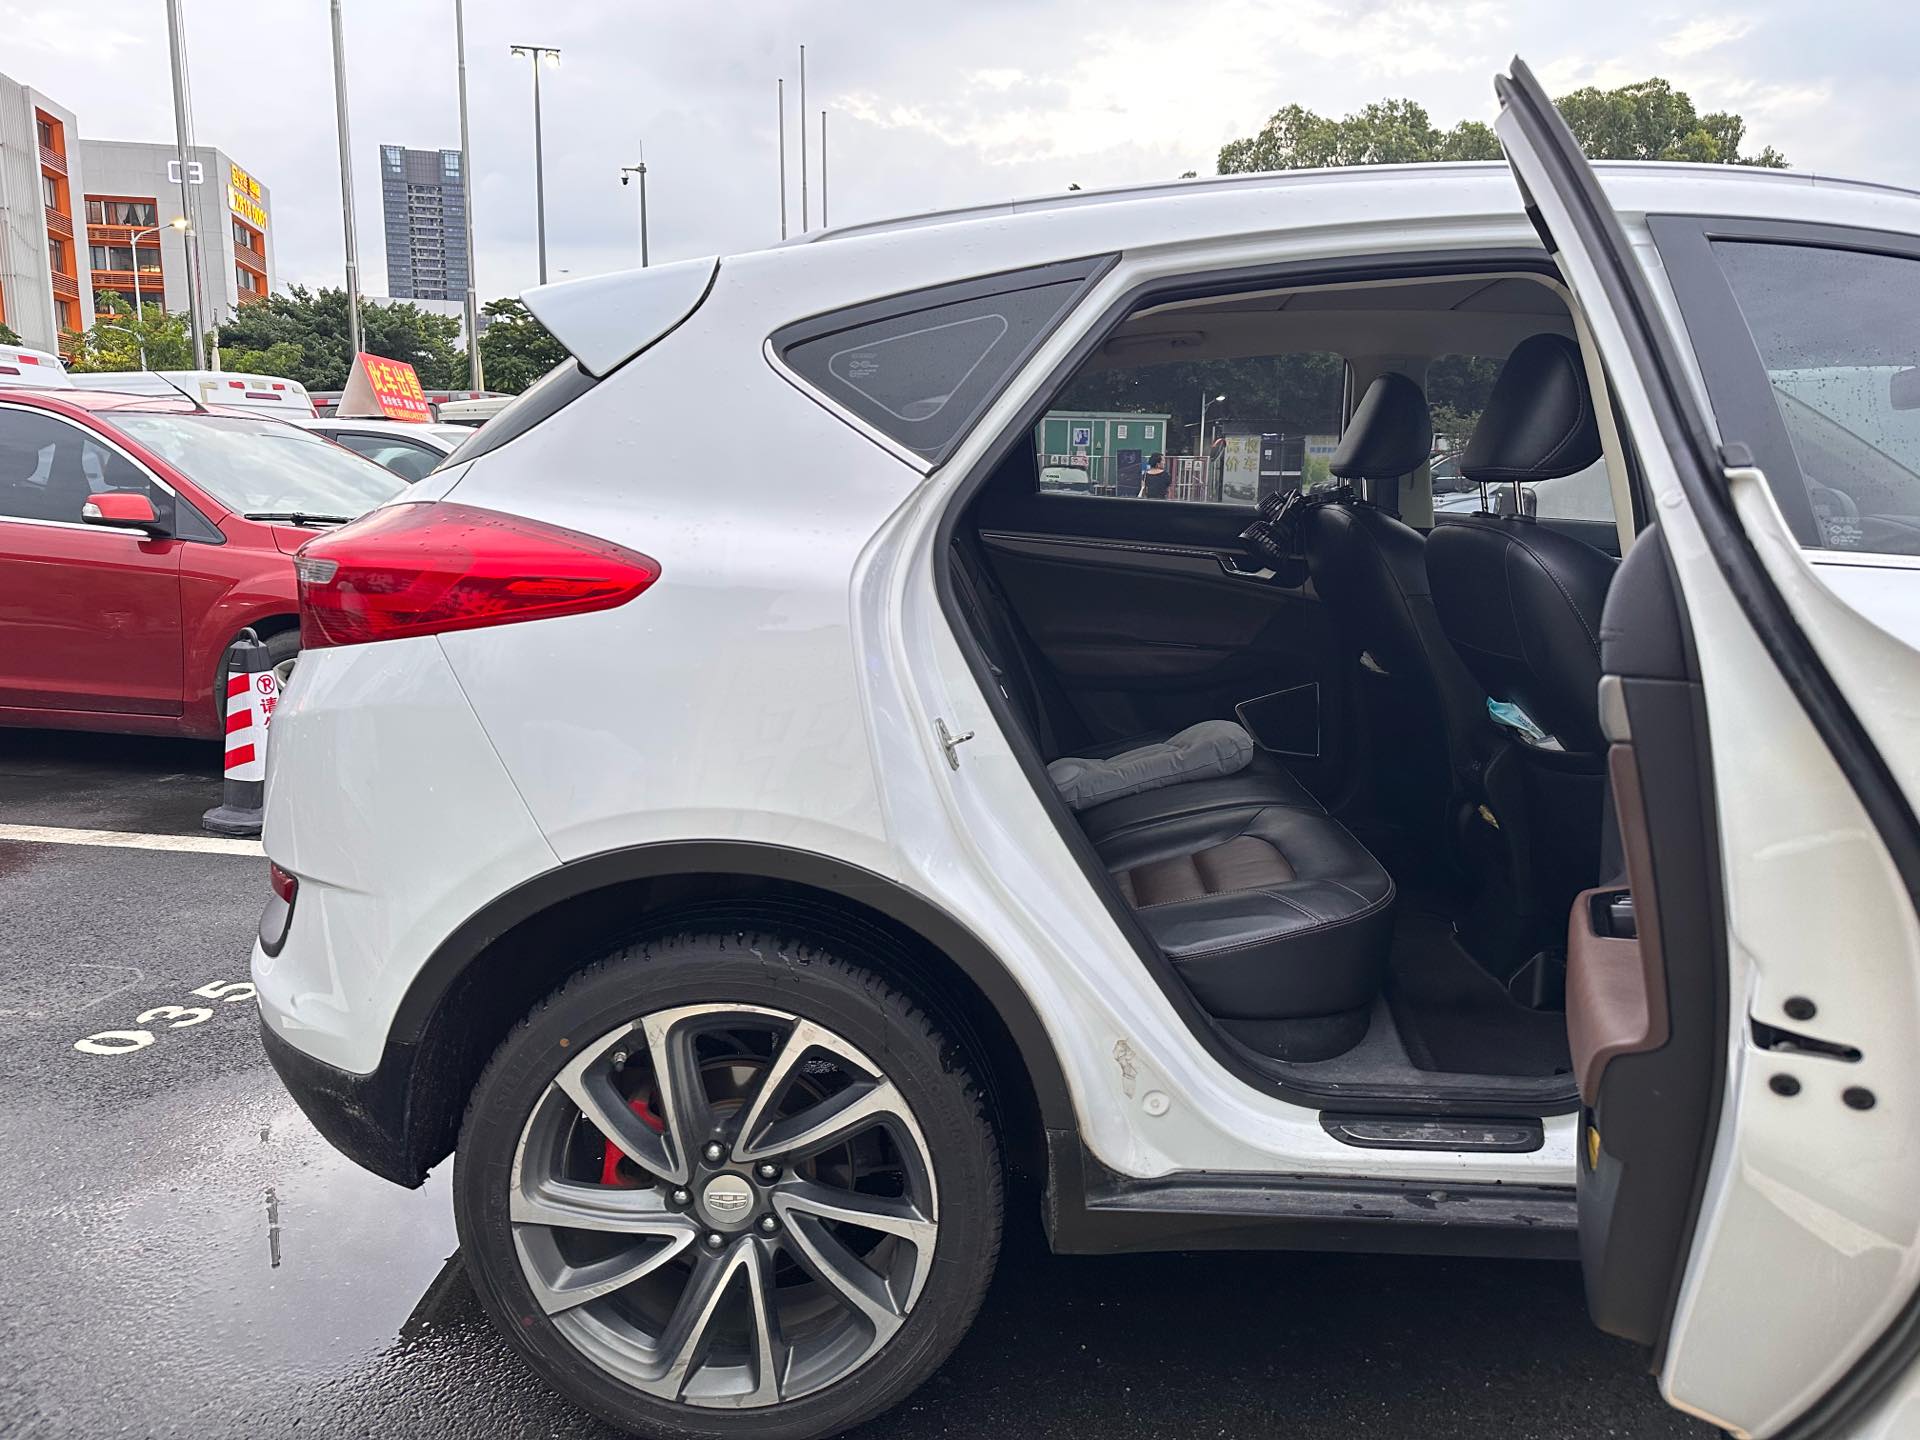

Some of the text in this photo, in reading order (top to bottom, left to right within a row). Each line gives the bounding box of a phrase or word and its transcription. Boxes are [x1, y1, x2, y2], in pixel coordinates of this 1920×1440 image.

[367, 360, 423, 401] 此车出售
[73, 979, 257, 1055] 035
